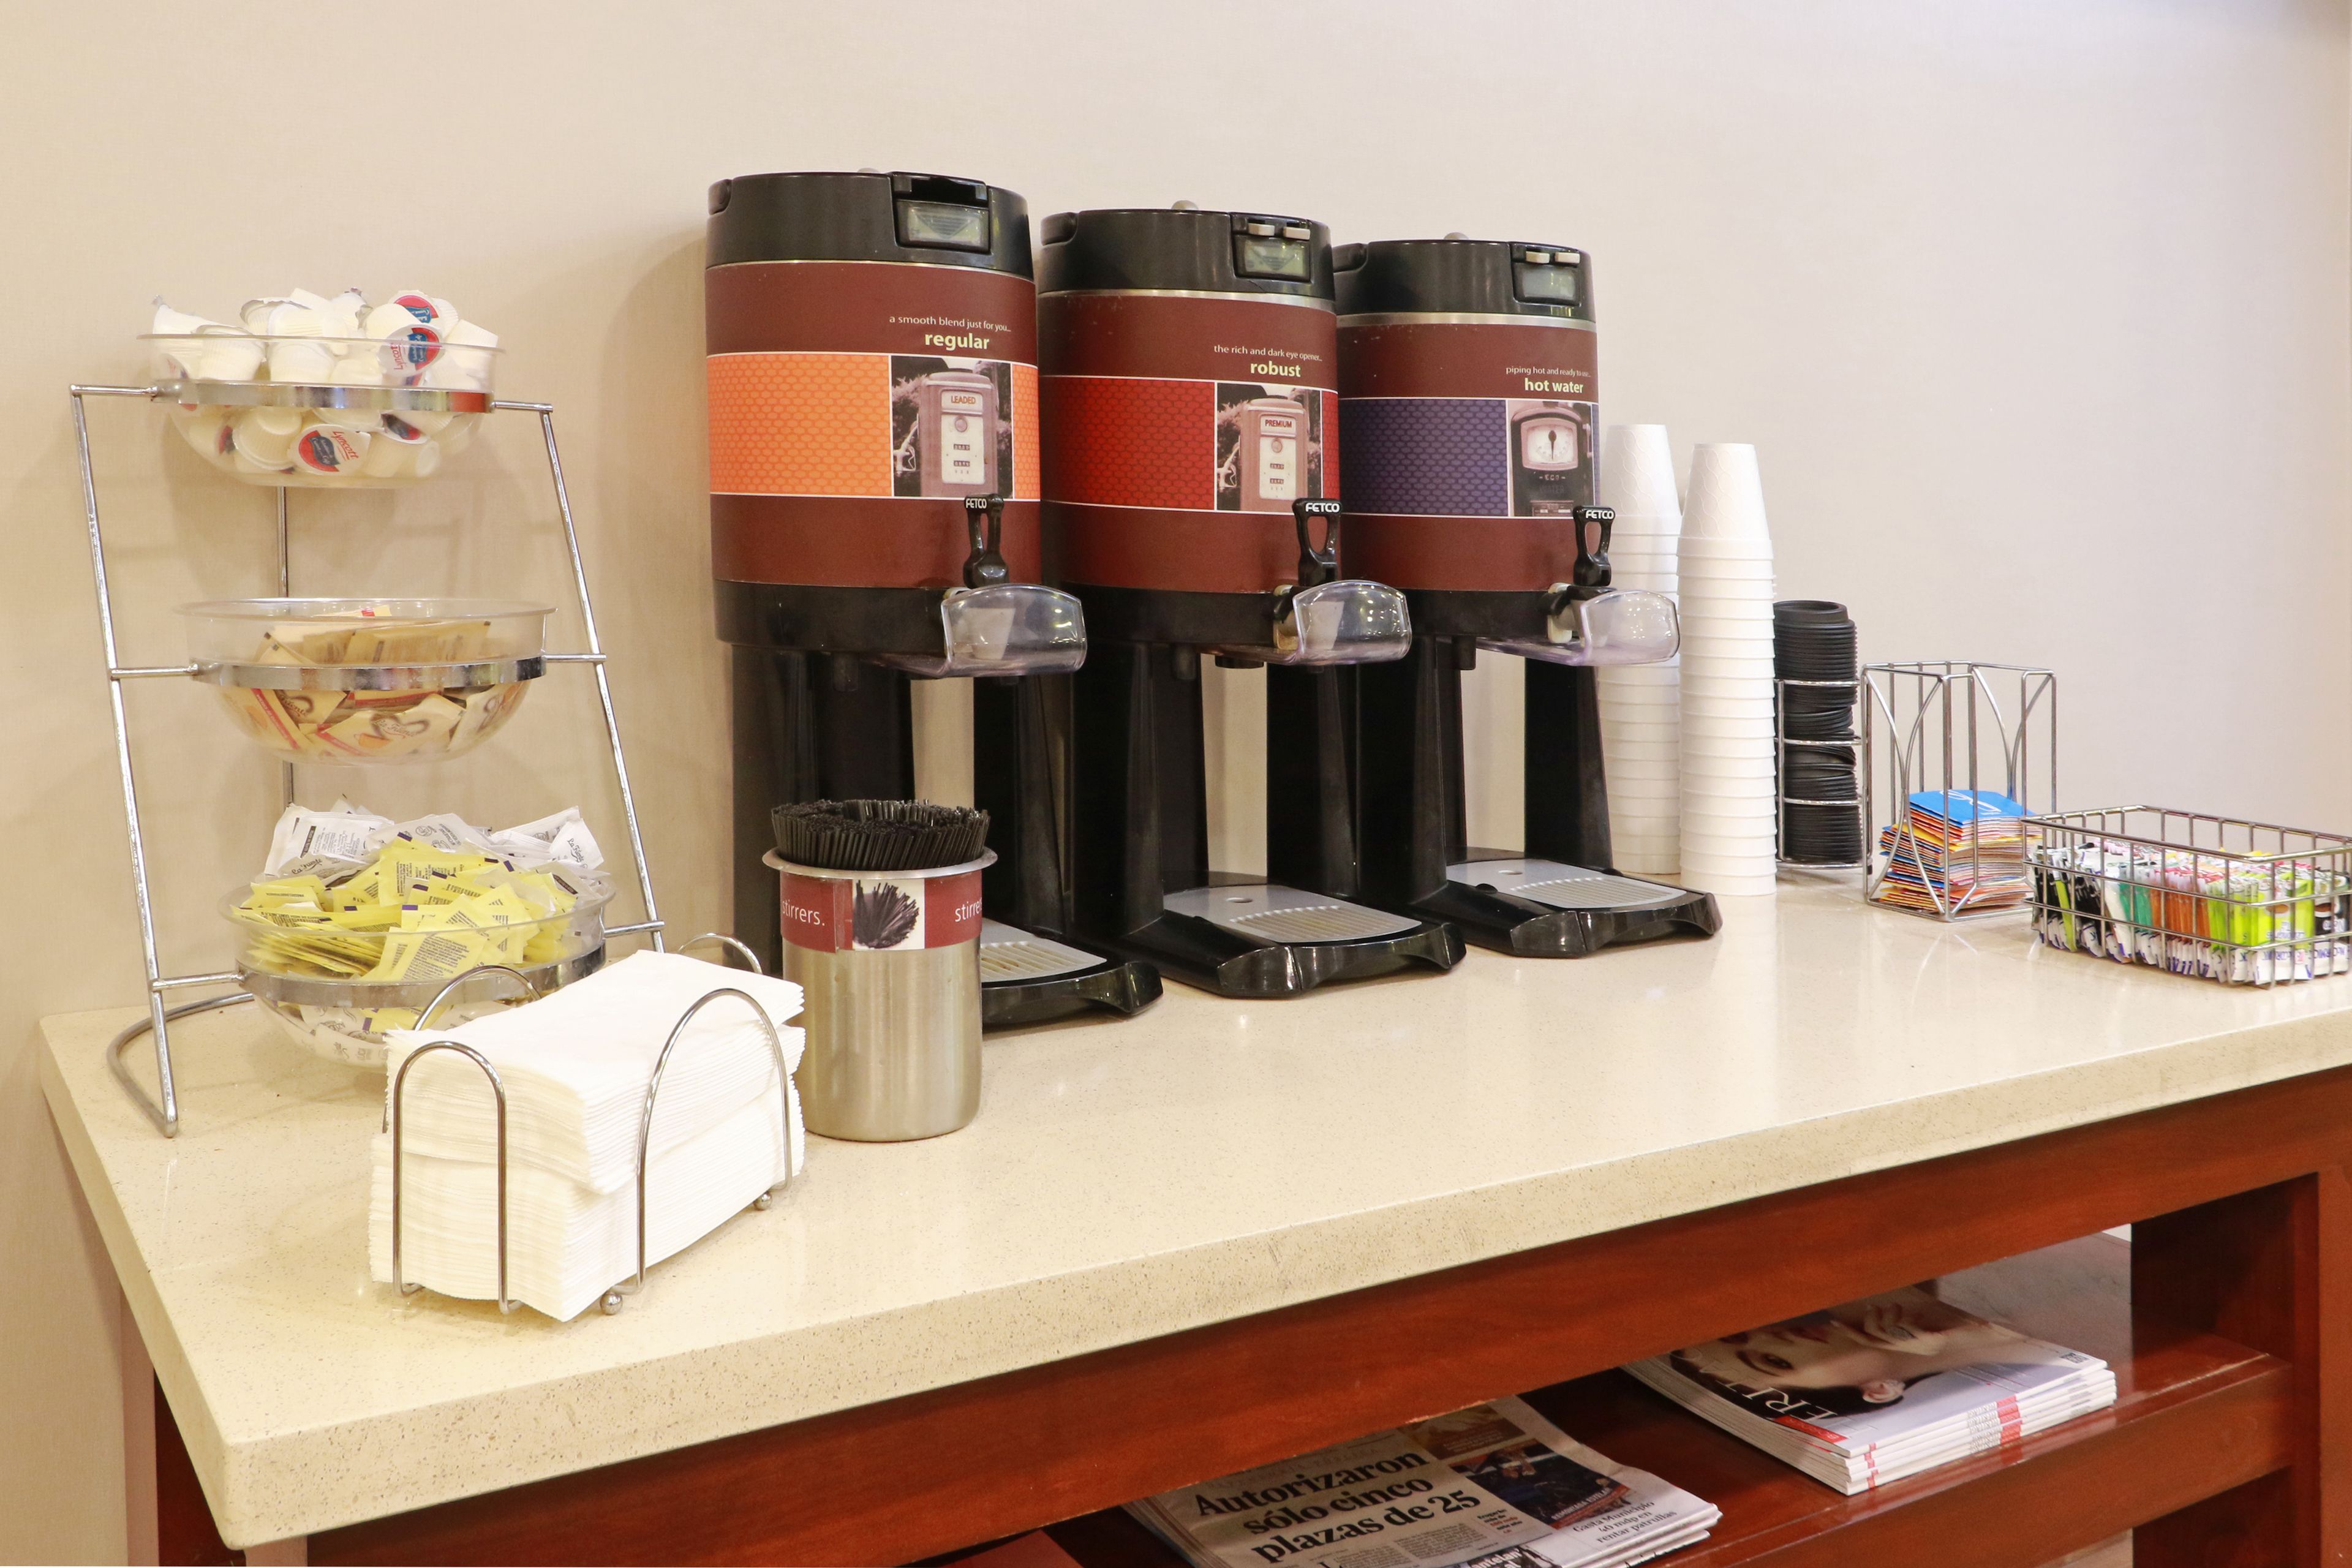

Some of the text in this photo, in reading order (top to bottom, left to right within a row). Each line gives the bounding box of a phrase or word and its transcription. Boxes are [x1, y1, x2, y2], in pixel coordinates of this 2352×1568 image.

[899, 316, 937, 325] smooth
[939, 317, 965, 327] blend
[967, 319, 982, 330] just
[983, 320, 993, 330] for
[925, 333, 990, 351] regular
[1214, 344, 1229, 353] the
[1231, 345, 1248, 355] rich
[1250, 347, 1266, 356] and
[1267, 348, 1284, 357] dark
[1286, 352, 1298, 360] eye
[1250, 360, 1301, 377] robust
[1506, 366, 1531, 375] piping
[1559, 369, 1576, 377] ready
[1525, 377, 1583, 393] hot water
[951, 395, 976, 404] LEADED
[1265, 419, 1292, 428] PREMIUM
[965, 497, 987, 510] FETCO
[1305, 502, 1340, 513] FETCO
[1585, 510, 1615, 520] FETCO
[782, 900, 826, 925] stirrers.
[955, 897, 982, 922] stirre
[1195, 1452, 1430, 1516] Autorizaron
[1243, 1479, 1433, 1534] sólo cinco
[1573, 1501, 1655, 1532] Gasta Municipio
[1615, 1517, 1639, 1528] mdp
[1638, 1510, 1652, 1519] en
[1251, 1518, 1384, 1564] plazas
[1384, 1504, 1434, 1527] de
[1428, 1490, 1480, 1514] 25
[1596, 1510, 1677, 1543] rentar patrullas
